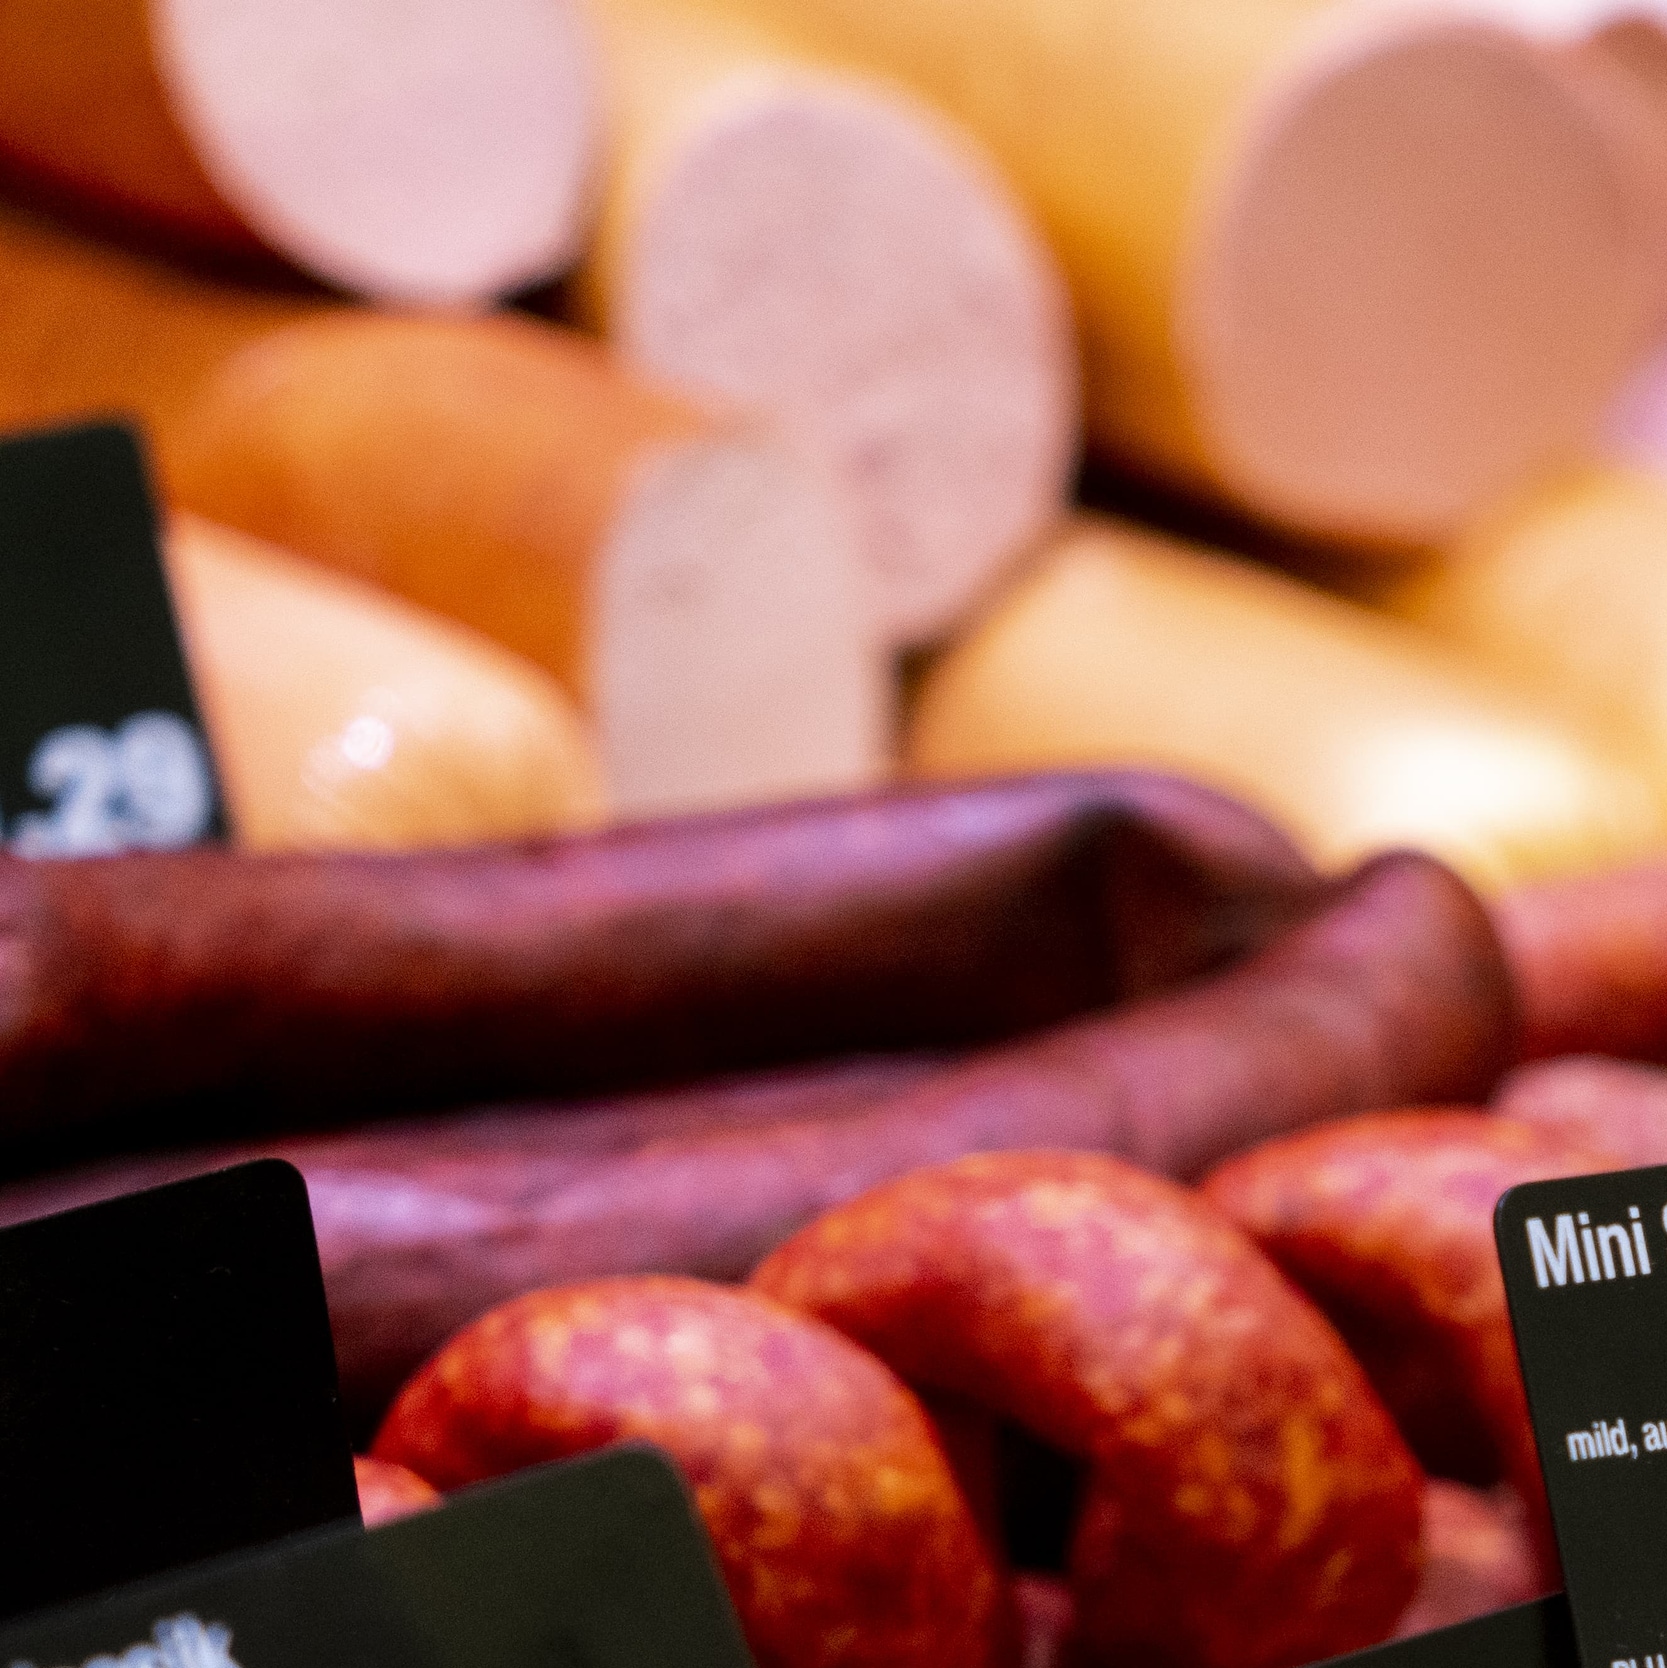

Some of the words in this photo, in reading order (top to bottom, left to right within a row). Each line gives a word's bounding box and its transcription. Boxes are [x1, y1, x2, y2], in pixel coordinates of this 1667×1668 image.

[5, 714, 212, 860] .29
[1526, 1205, 1652, 1289] Mini
[1565, 1417, 1639, 1461] mild,
